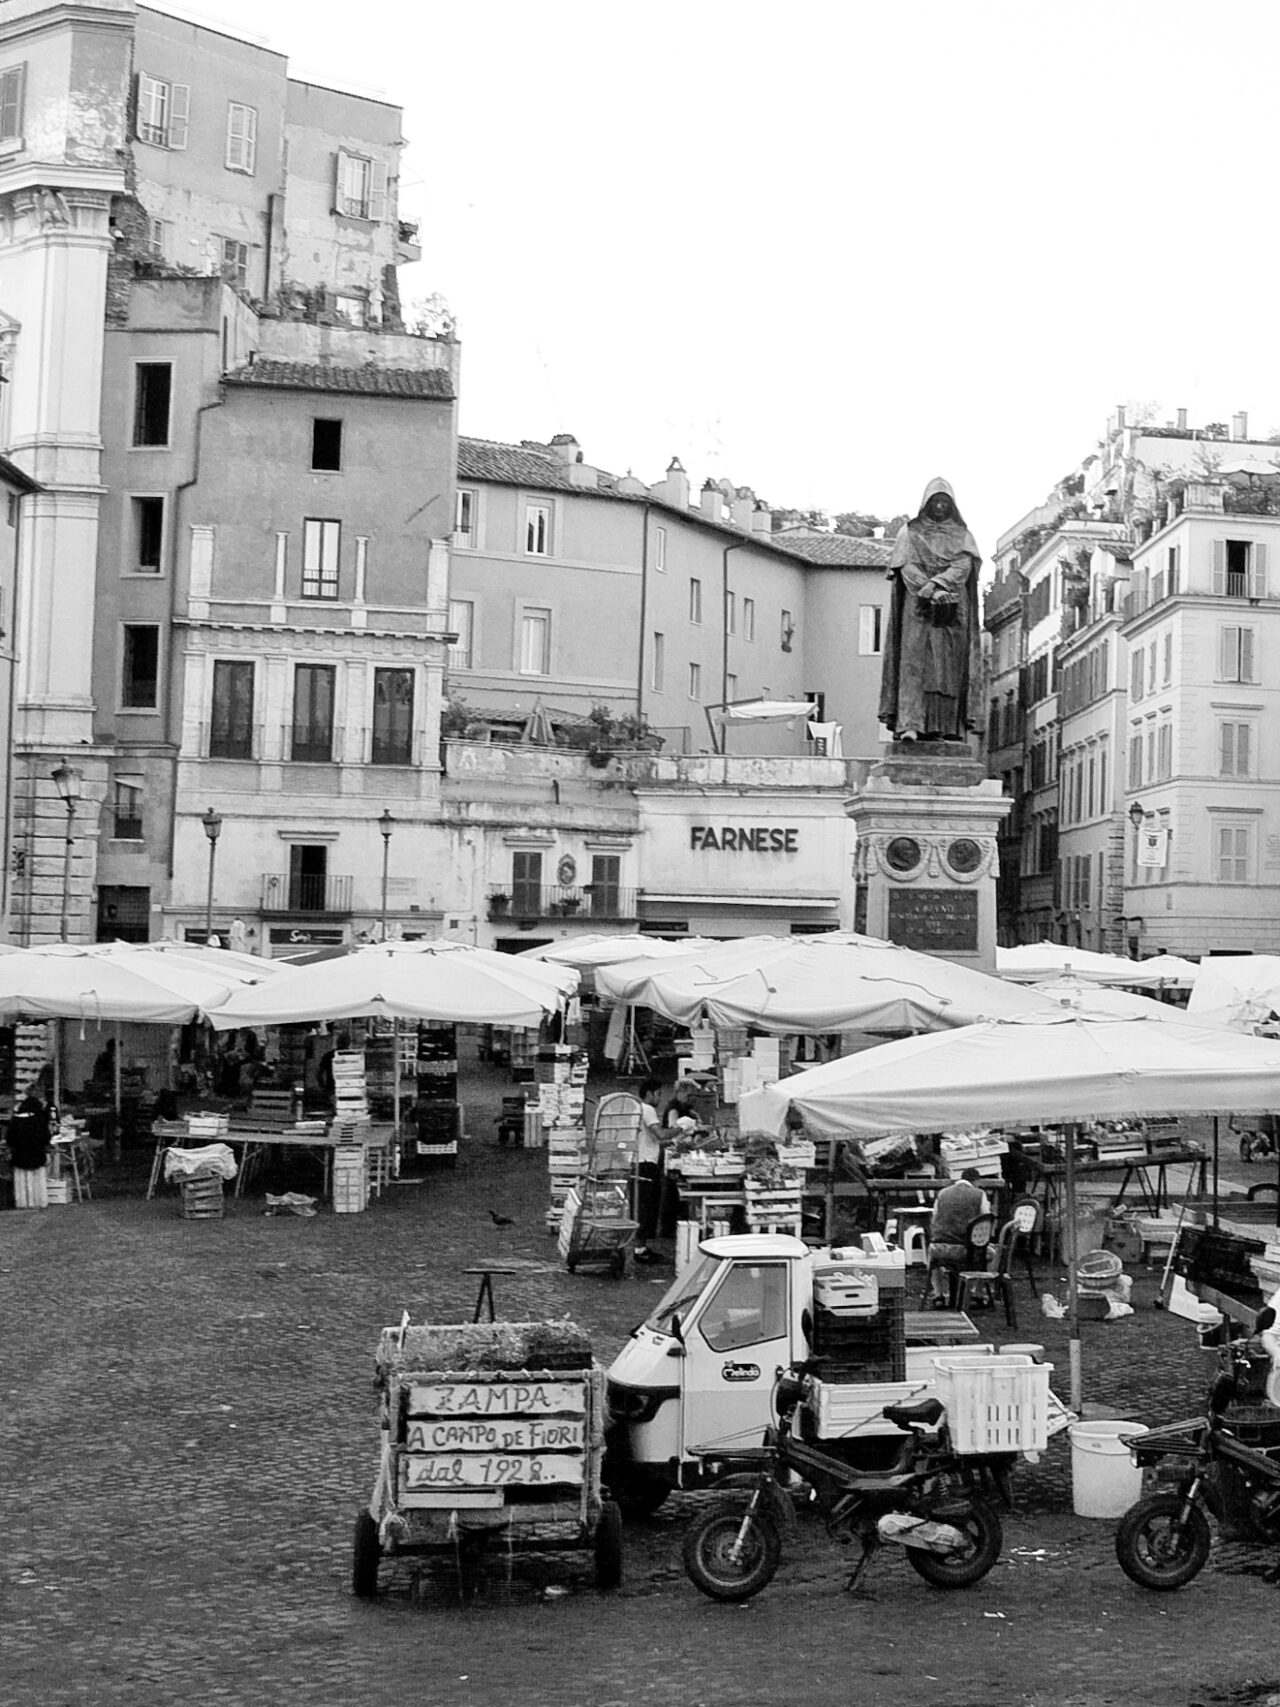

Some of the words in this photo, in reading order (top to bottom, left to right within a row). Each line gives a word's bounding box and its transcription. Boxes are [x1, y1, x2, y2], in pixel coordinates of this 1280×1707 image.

[690, 826, 799, 853] FARNESE
[434, 1385, 551, 1412] ZAMPA
[409, 1426, 426, 1449] A
[502, 1430, 525, 1448] DE
[528, 1422, 578, 1447] FIORI
[416, 1458, 465, 1482] dal
